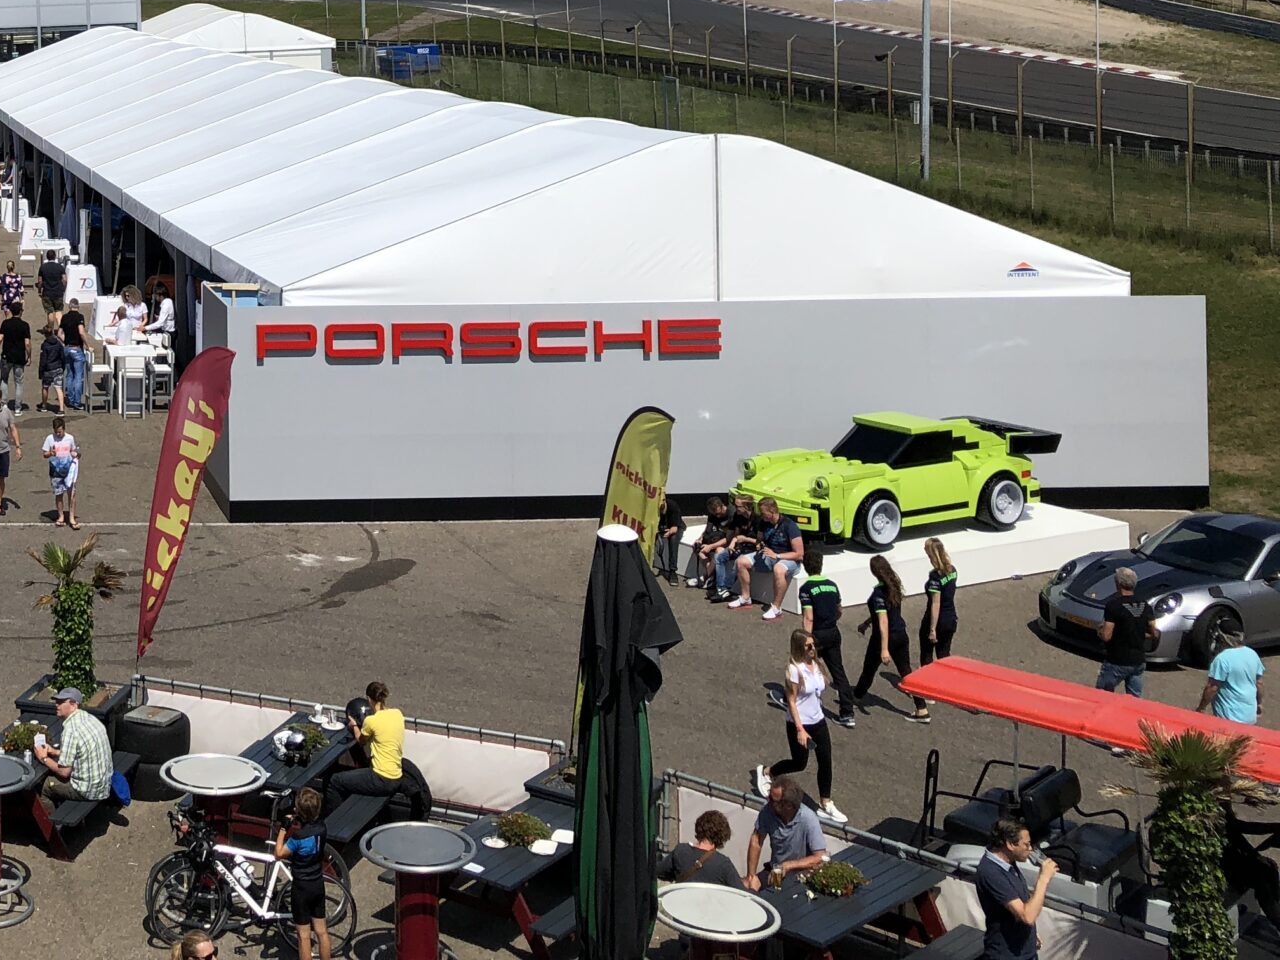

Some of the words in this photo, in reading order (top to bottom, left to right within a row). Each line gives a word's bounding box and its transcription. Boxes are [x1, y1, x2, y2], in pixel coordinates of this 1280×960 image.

[80, 278, 94, 289] 70
[256, 318, 722, 360] PORSCHE
[146, 396, 216, 610] ickey's
